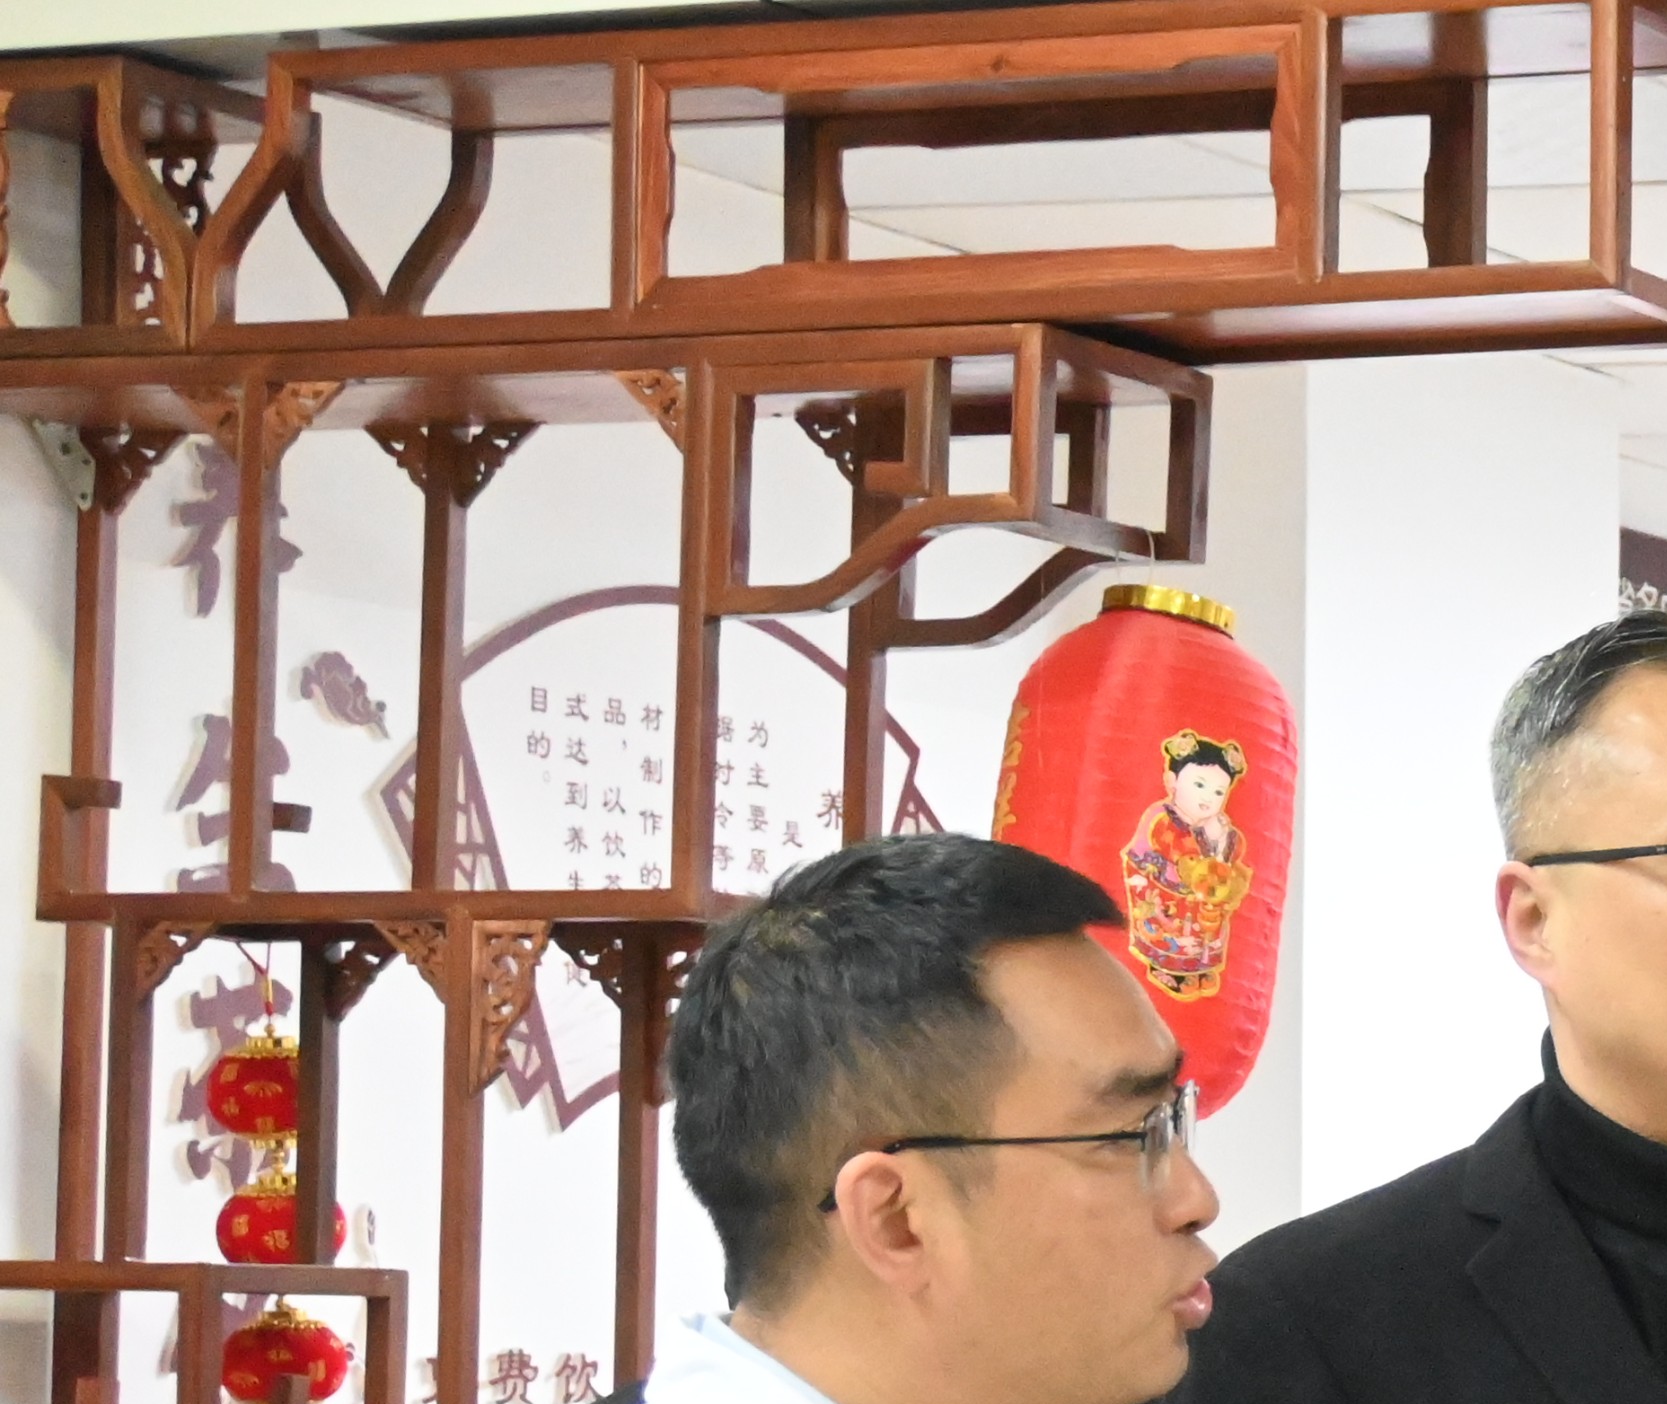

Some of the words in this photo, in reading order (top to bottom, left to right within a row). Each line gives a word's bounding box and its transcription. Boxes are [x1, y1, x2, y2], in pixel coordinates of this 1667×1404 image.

[639, 703, 664, 889] 材制作的
[746, 720, 770, 875] 为主要原
[782, 820, 804, 850] 是
